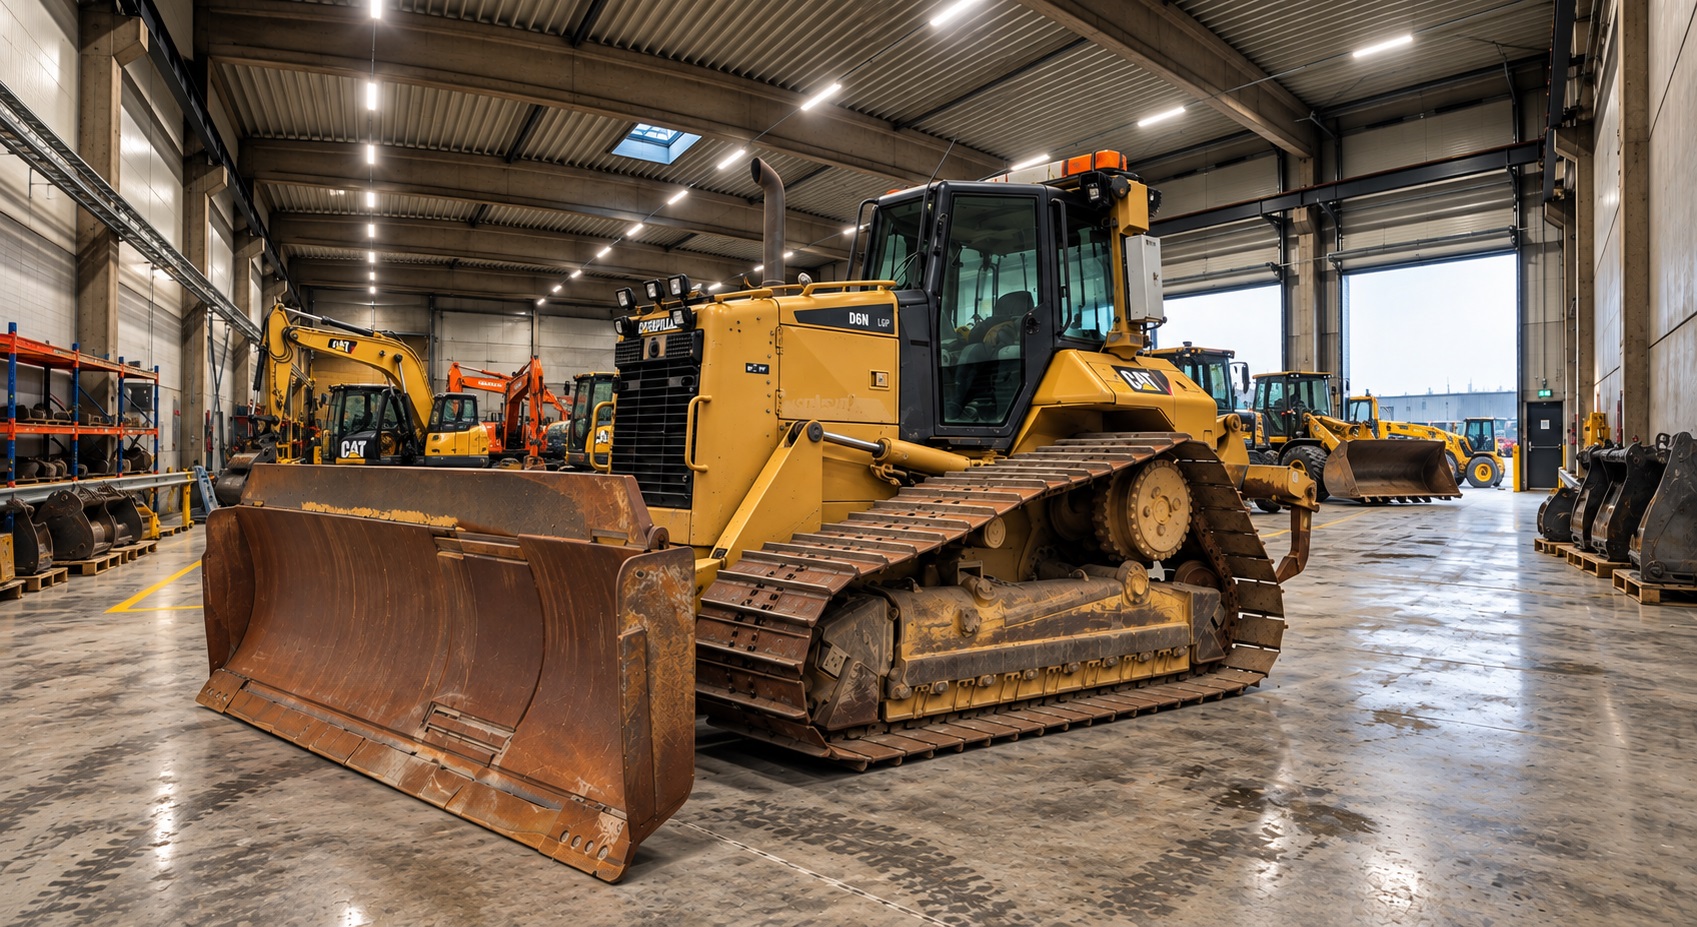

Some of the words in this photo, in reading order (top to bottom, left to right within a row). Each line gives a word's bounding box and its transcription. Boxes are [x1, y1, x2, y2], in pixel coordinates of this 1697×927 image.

[849, 312, 869, 326] D6N
[1120, 370, 1162, 392] CAT
[341, 440, 367, 458] CAT
